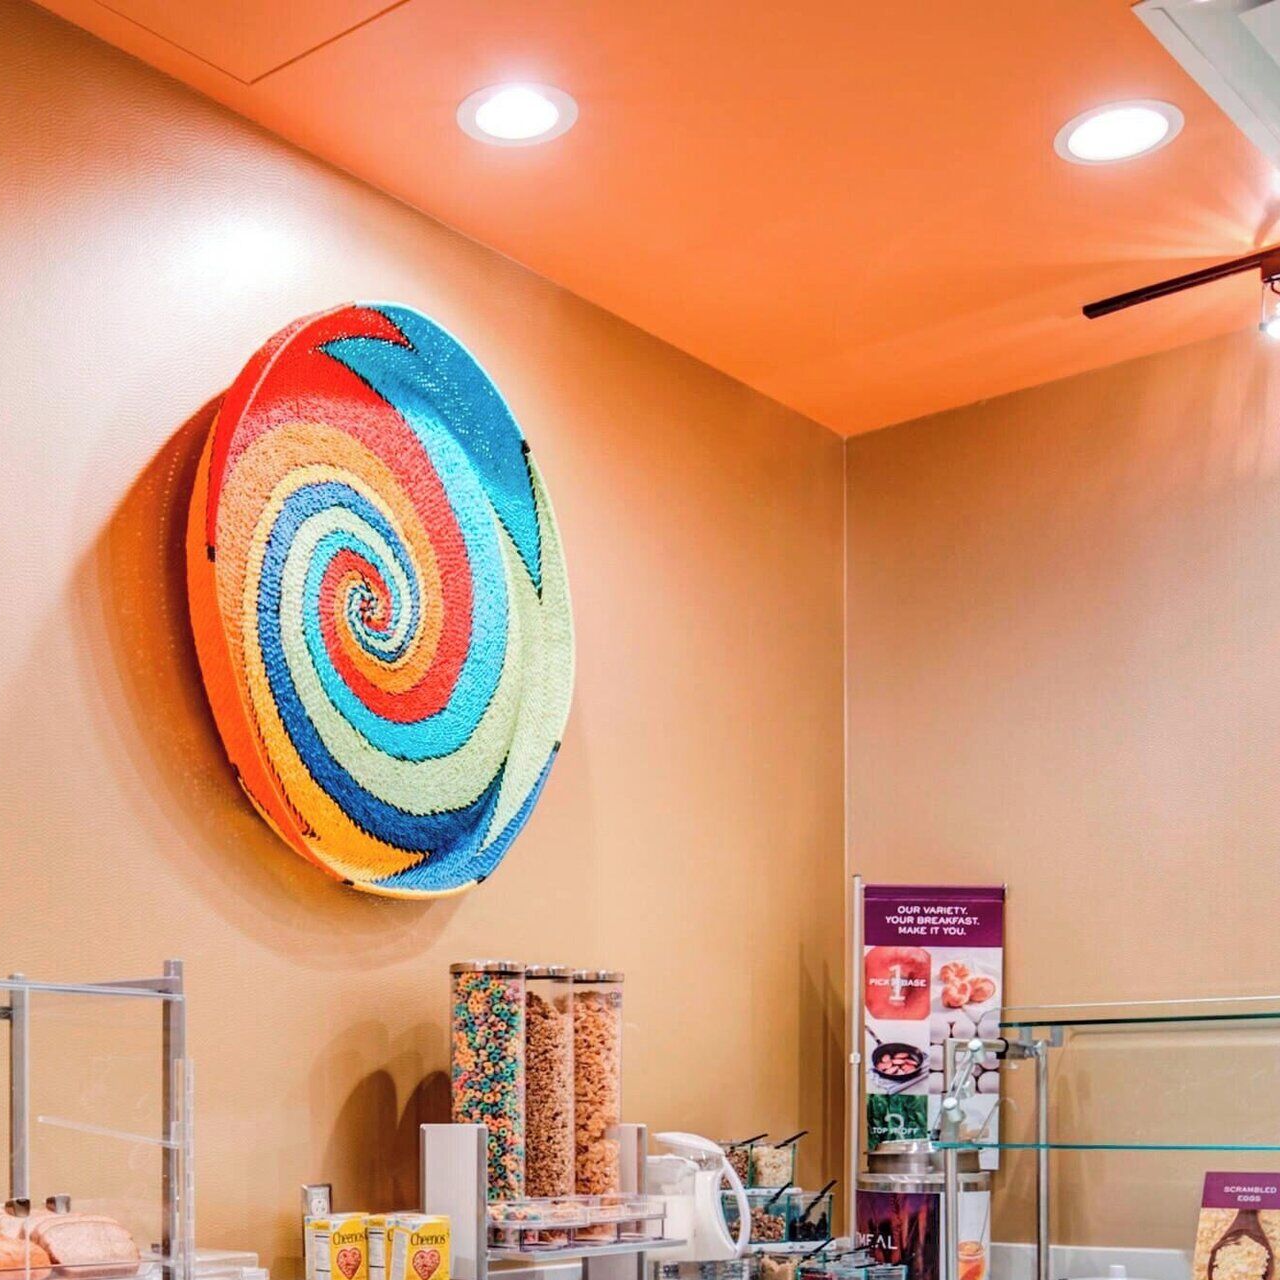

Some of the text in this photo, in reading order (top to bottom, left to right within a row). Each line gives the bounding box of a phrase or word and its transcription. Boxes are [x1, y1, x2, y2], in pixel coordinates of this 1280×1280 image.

[897, 905, 968, 915] OUR VARIETY.
[885, 915, 980, 925] YOUR BREAKFAST.
[898, 926, 967, 936] MAKE IT YOU.
[410, 1232, 446, 1247] Cheerios
